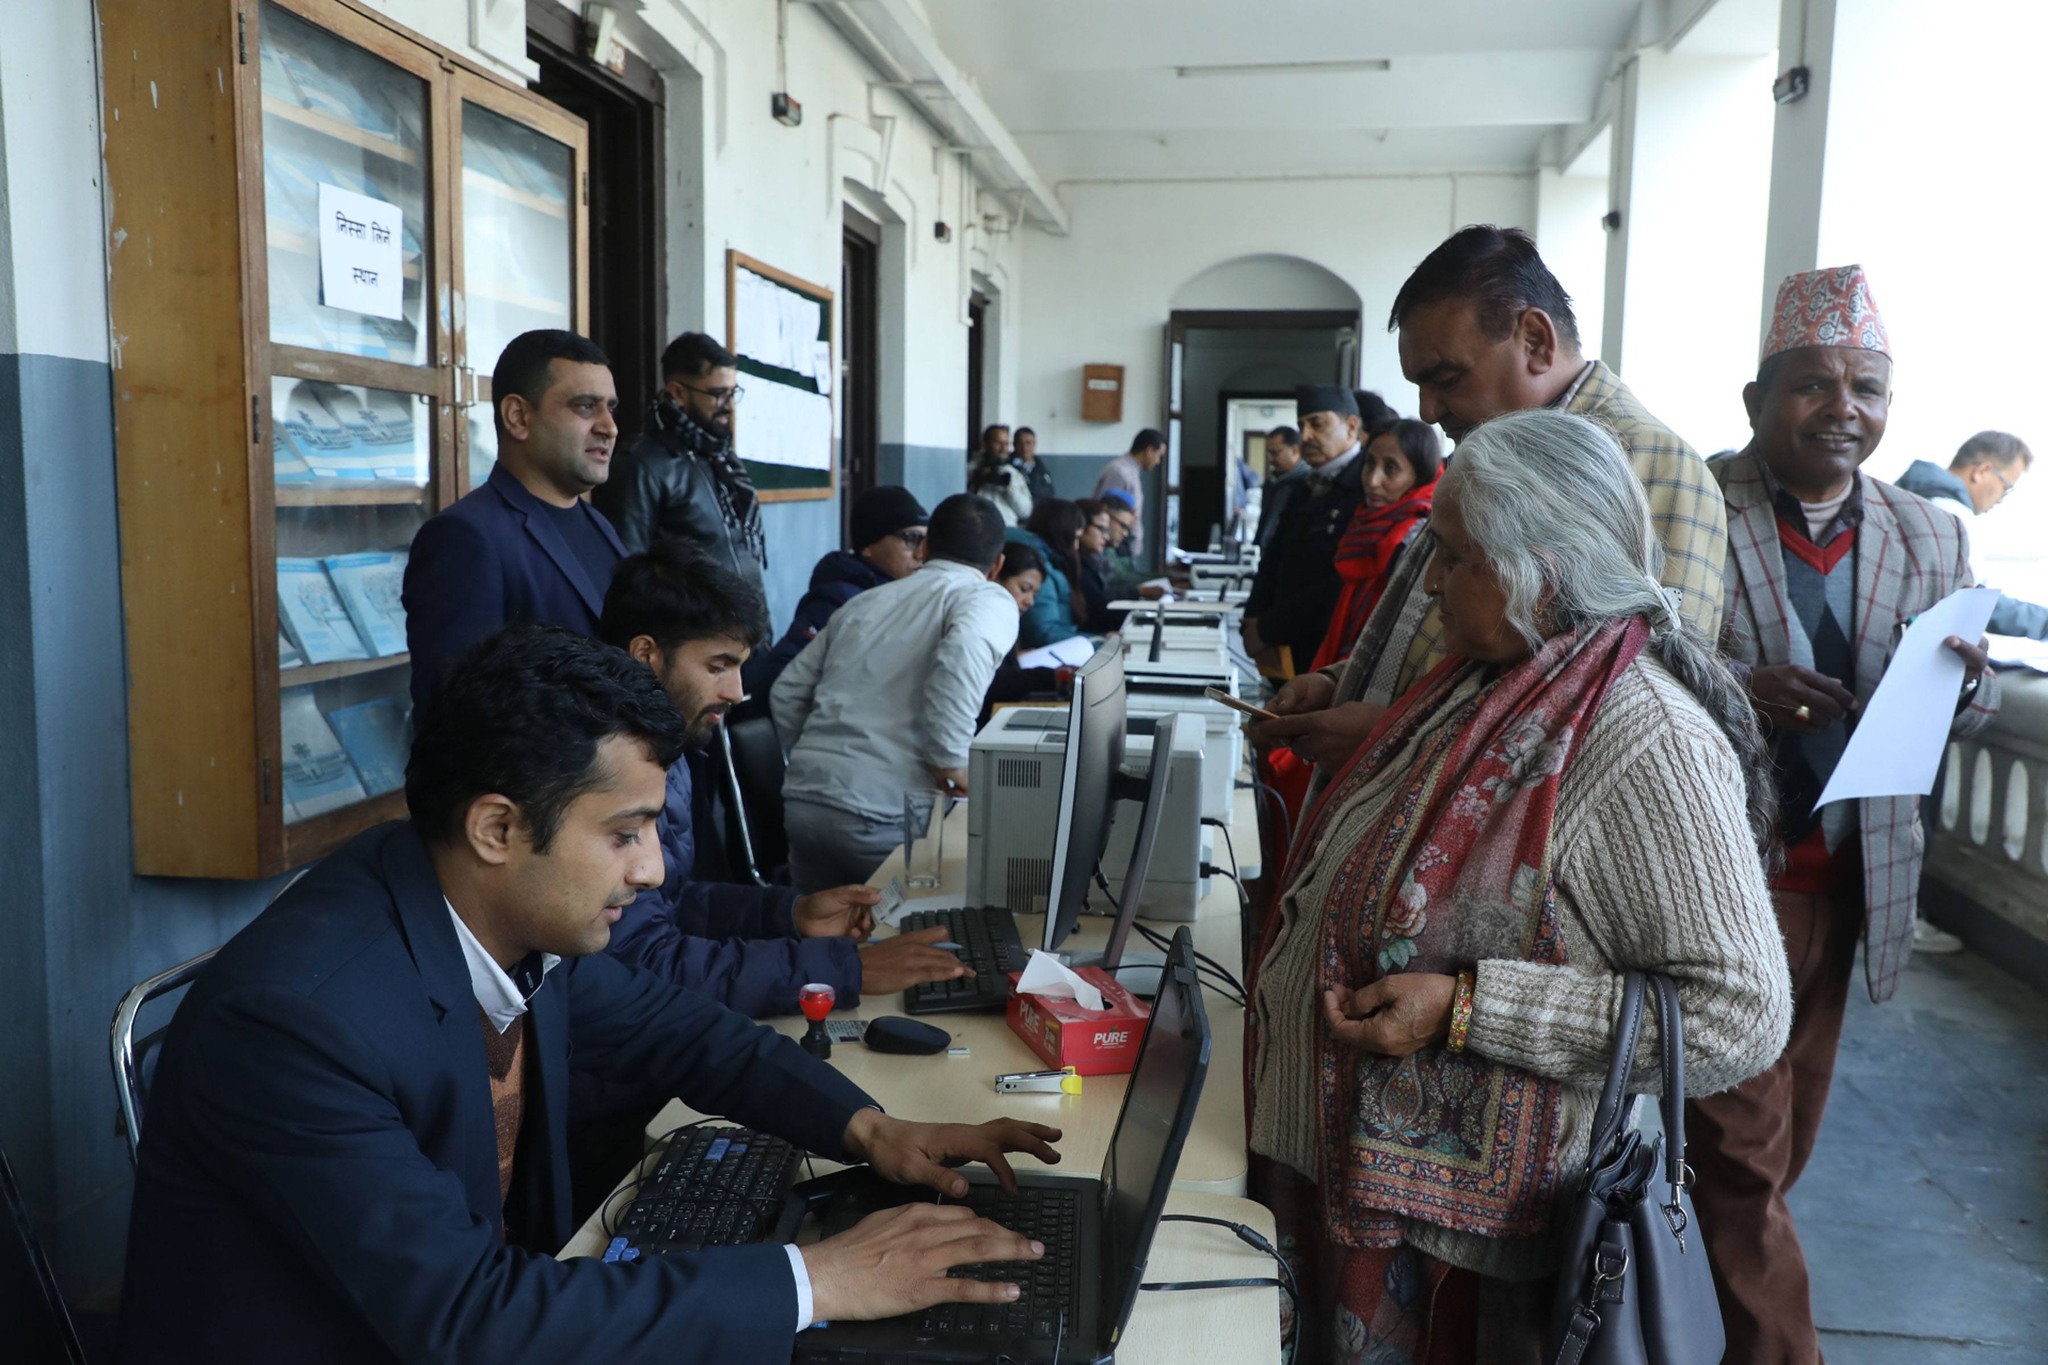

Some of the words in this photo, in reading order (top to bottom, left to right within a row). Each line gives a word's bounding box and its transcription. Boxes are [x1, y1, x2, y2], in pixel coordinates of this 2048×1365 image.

[336, 211, 366, 240] निस्सा
[372, 221, 391, 246] लिने
[353, 267, 378, 288] स्थान
[1020, 1000, 1039, 1034] PURE
[1093, 1031, 1128, 1044] PURE
